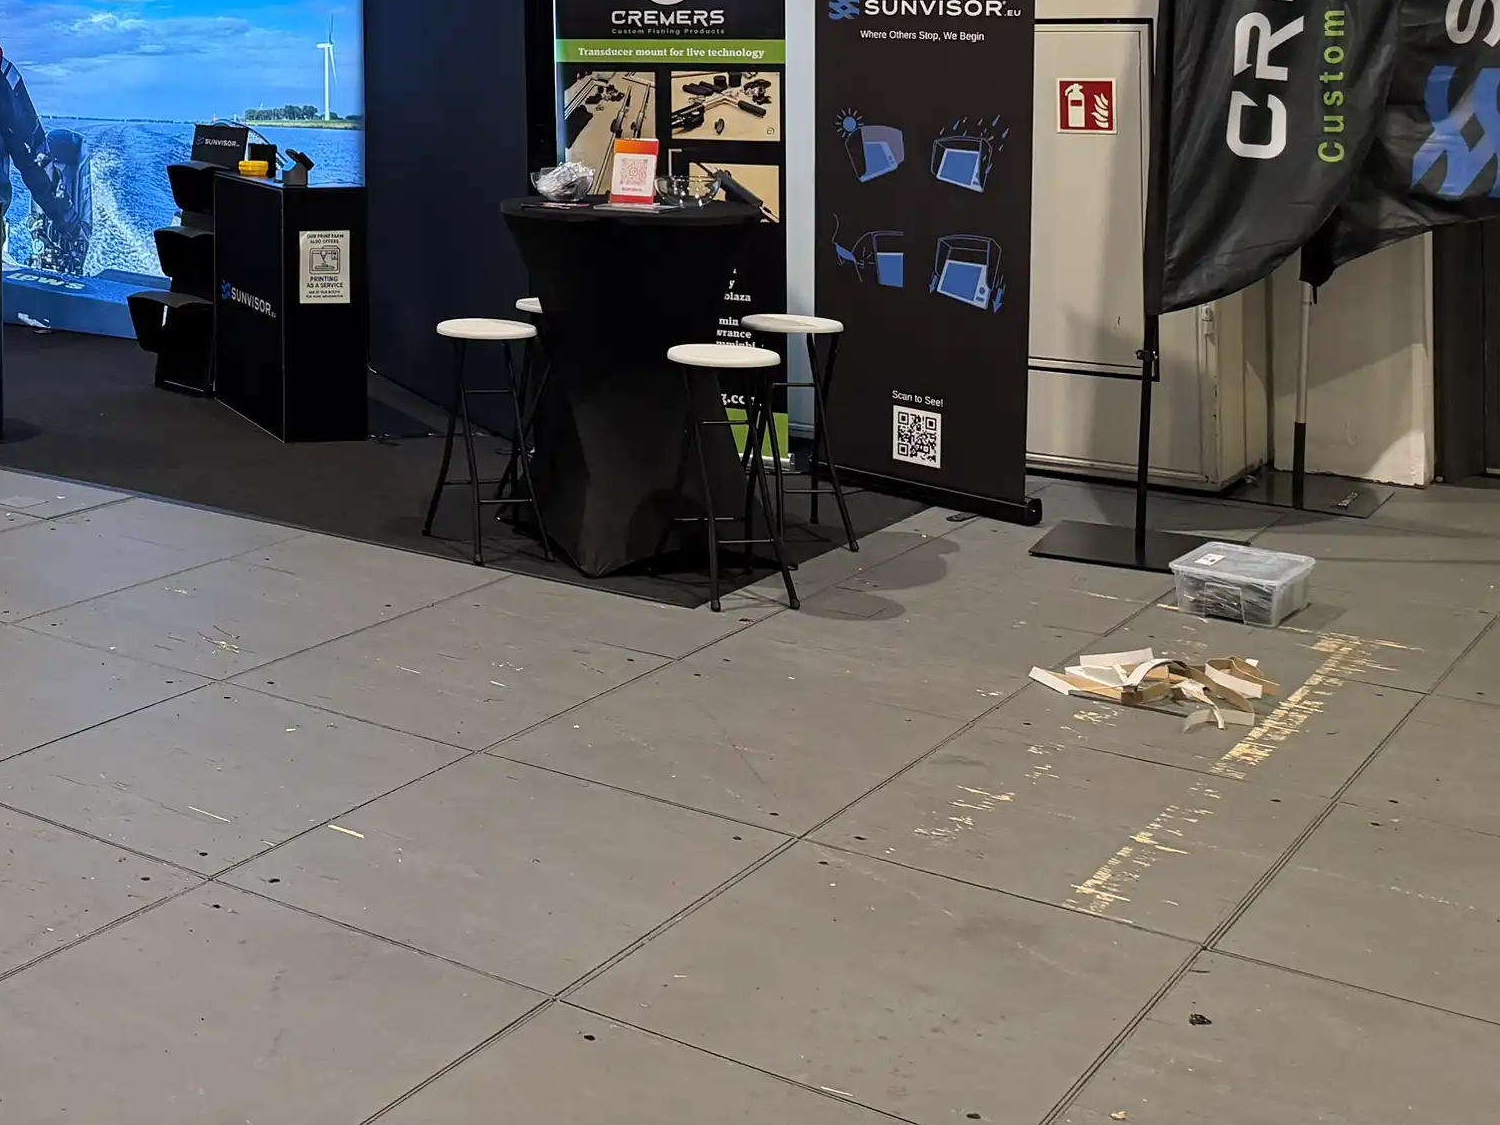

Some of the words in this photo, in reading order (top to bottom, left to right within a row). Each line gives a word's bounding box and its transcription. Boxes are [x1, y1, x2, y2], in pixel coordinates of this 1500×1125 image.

[611, 10, 725, 27] CREMERS
[611, 27, 645, 35] Custom
[647, 27, 681, 36] Fishing
[860, 30, 887, 39] Where
[889, 30, 917, 40] Others
[919, 31, 941, 42] Stop,
[943, 31, 957, 41] We
[960, 32, 985, 43] Begin
[578, 47, 634, 57] Transducer
[635, 48, 668, 57] mount
[669, 47, 685, 57] for
[687, 47, 706, 57] live
[708, 48, 765, 59] technology
[1317, 8, 1346, 164] Custom
[892, 389, 913, 402] Scan
[914, 394, 923, 404] to
[924, 396, 944, 408] See!
